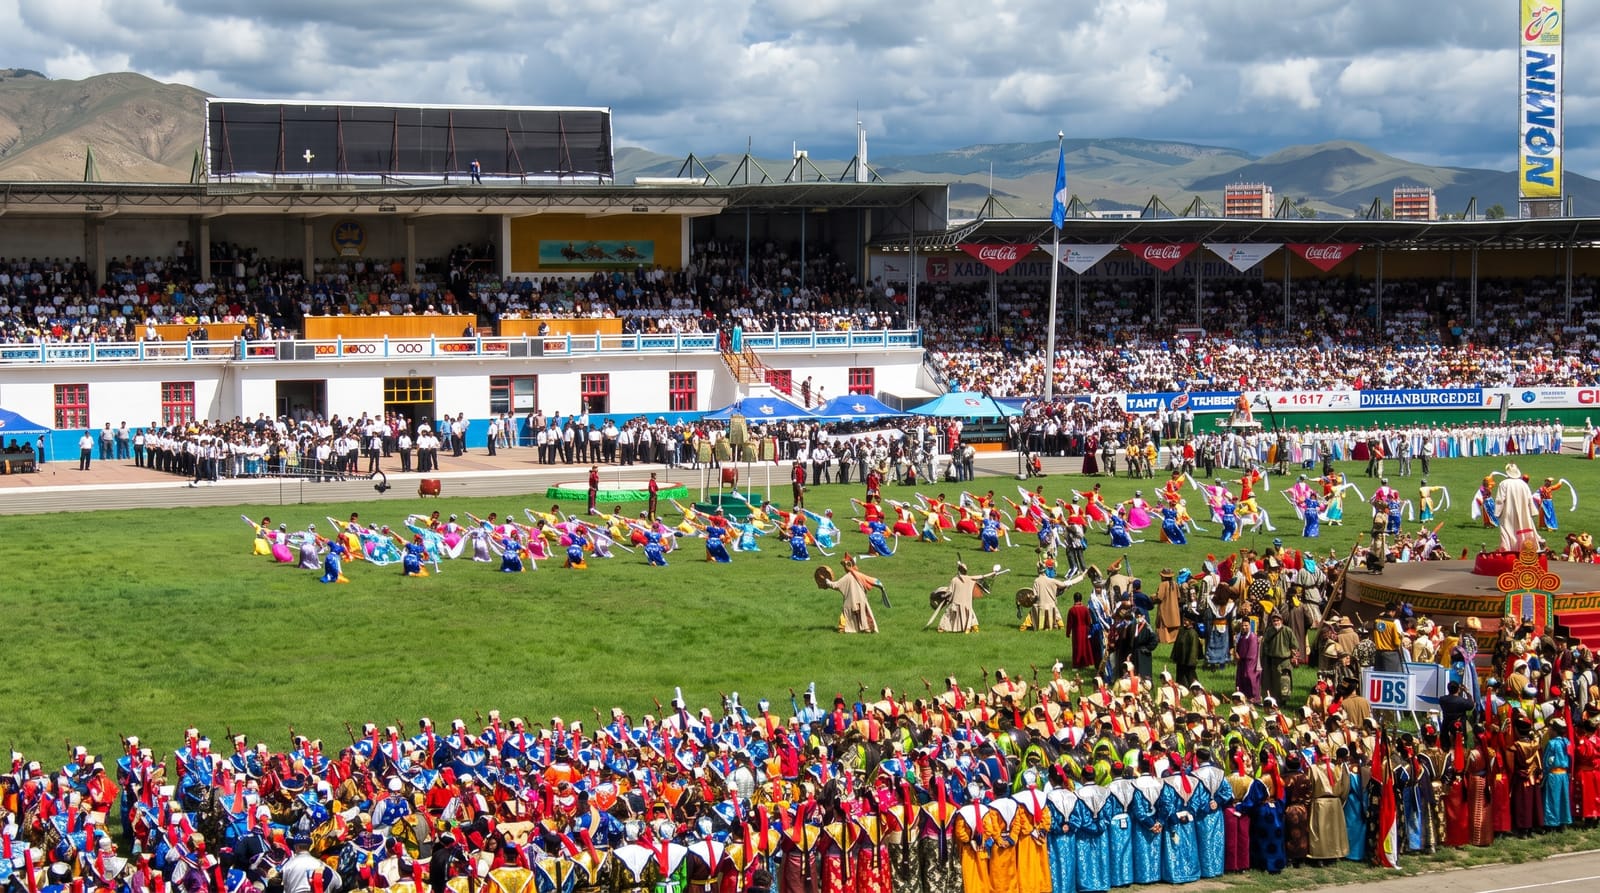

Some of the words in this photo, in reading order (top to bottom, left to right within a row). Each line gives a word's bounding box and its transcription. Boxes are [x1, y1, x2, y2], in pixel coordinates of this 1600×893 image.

[1525, 50, 1556, 187] NOMIN
[1292, 394, 1324, 405] 1617
[1370, 679, 1406, 705] UBS
